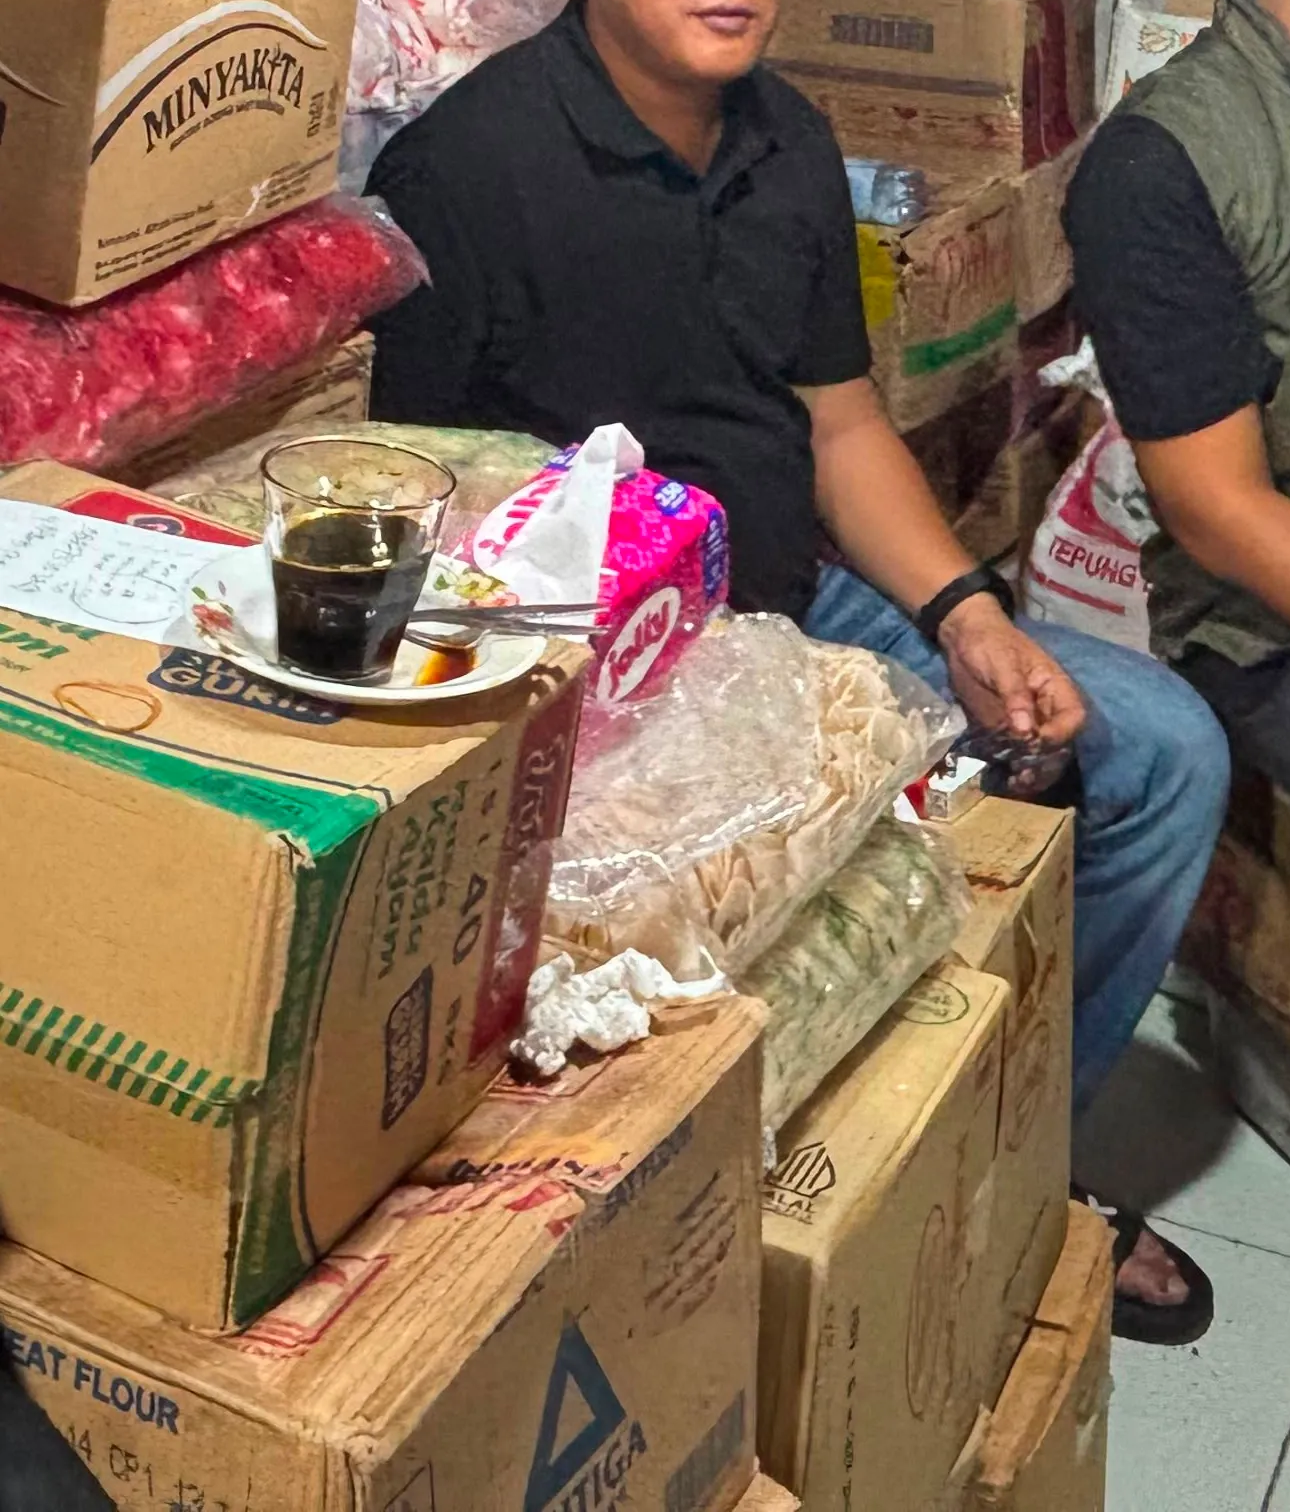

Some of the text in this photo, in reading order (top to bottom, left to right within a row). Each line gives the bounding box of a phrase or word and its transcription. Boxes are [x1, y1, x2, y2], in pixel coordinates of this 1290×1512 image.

[142, 41, 305, 155] MINYAKITA
[1048, 535, 1138, 589] TEPUNG
[608, 601, 671, 699] jolly
[73, 1357, 181, 1436] FLOUR
